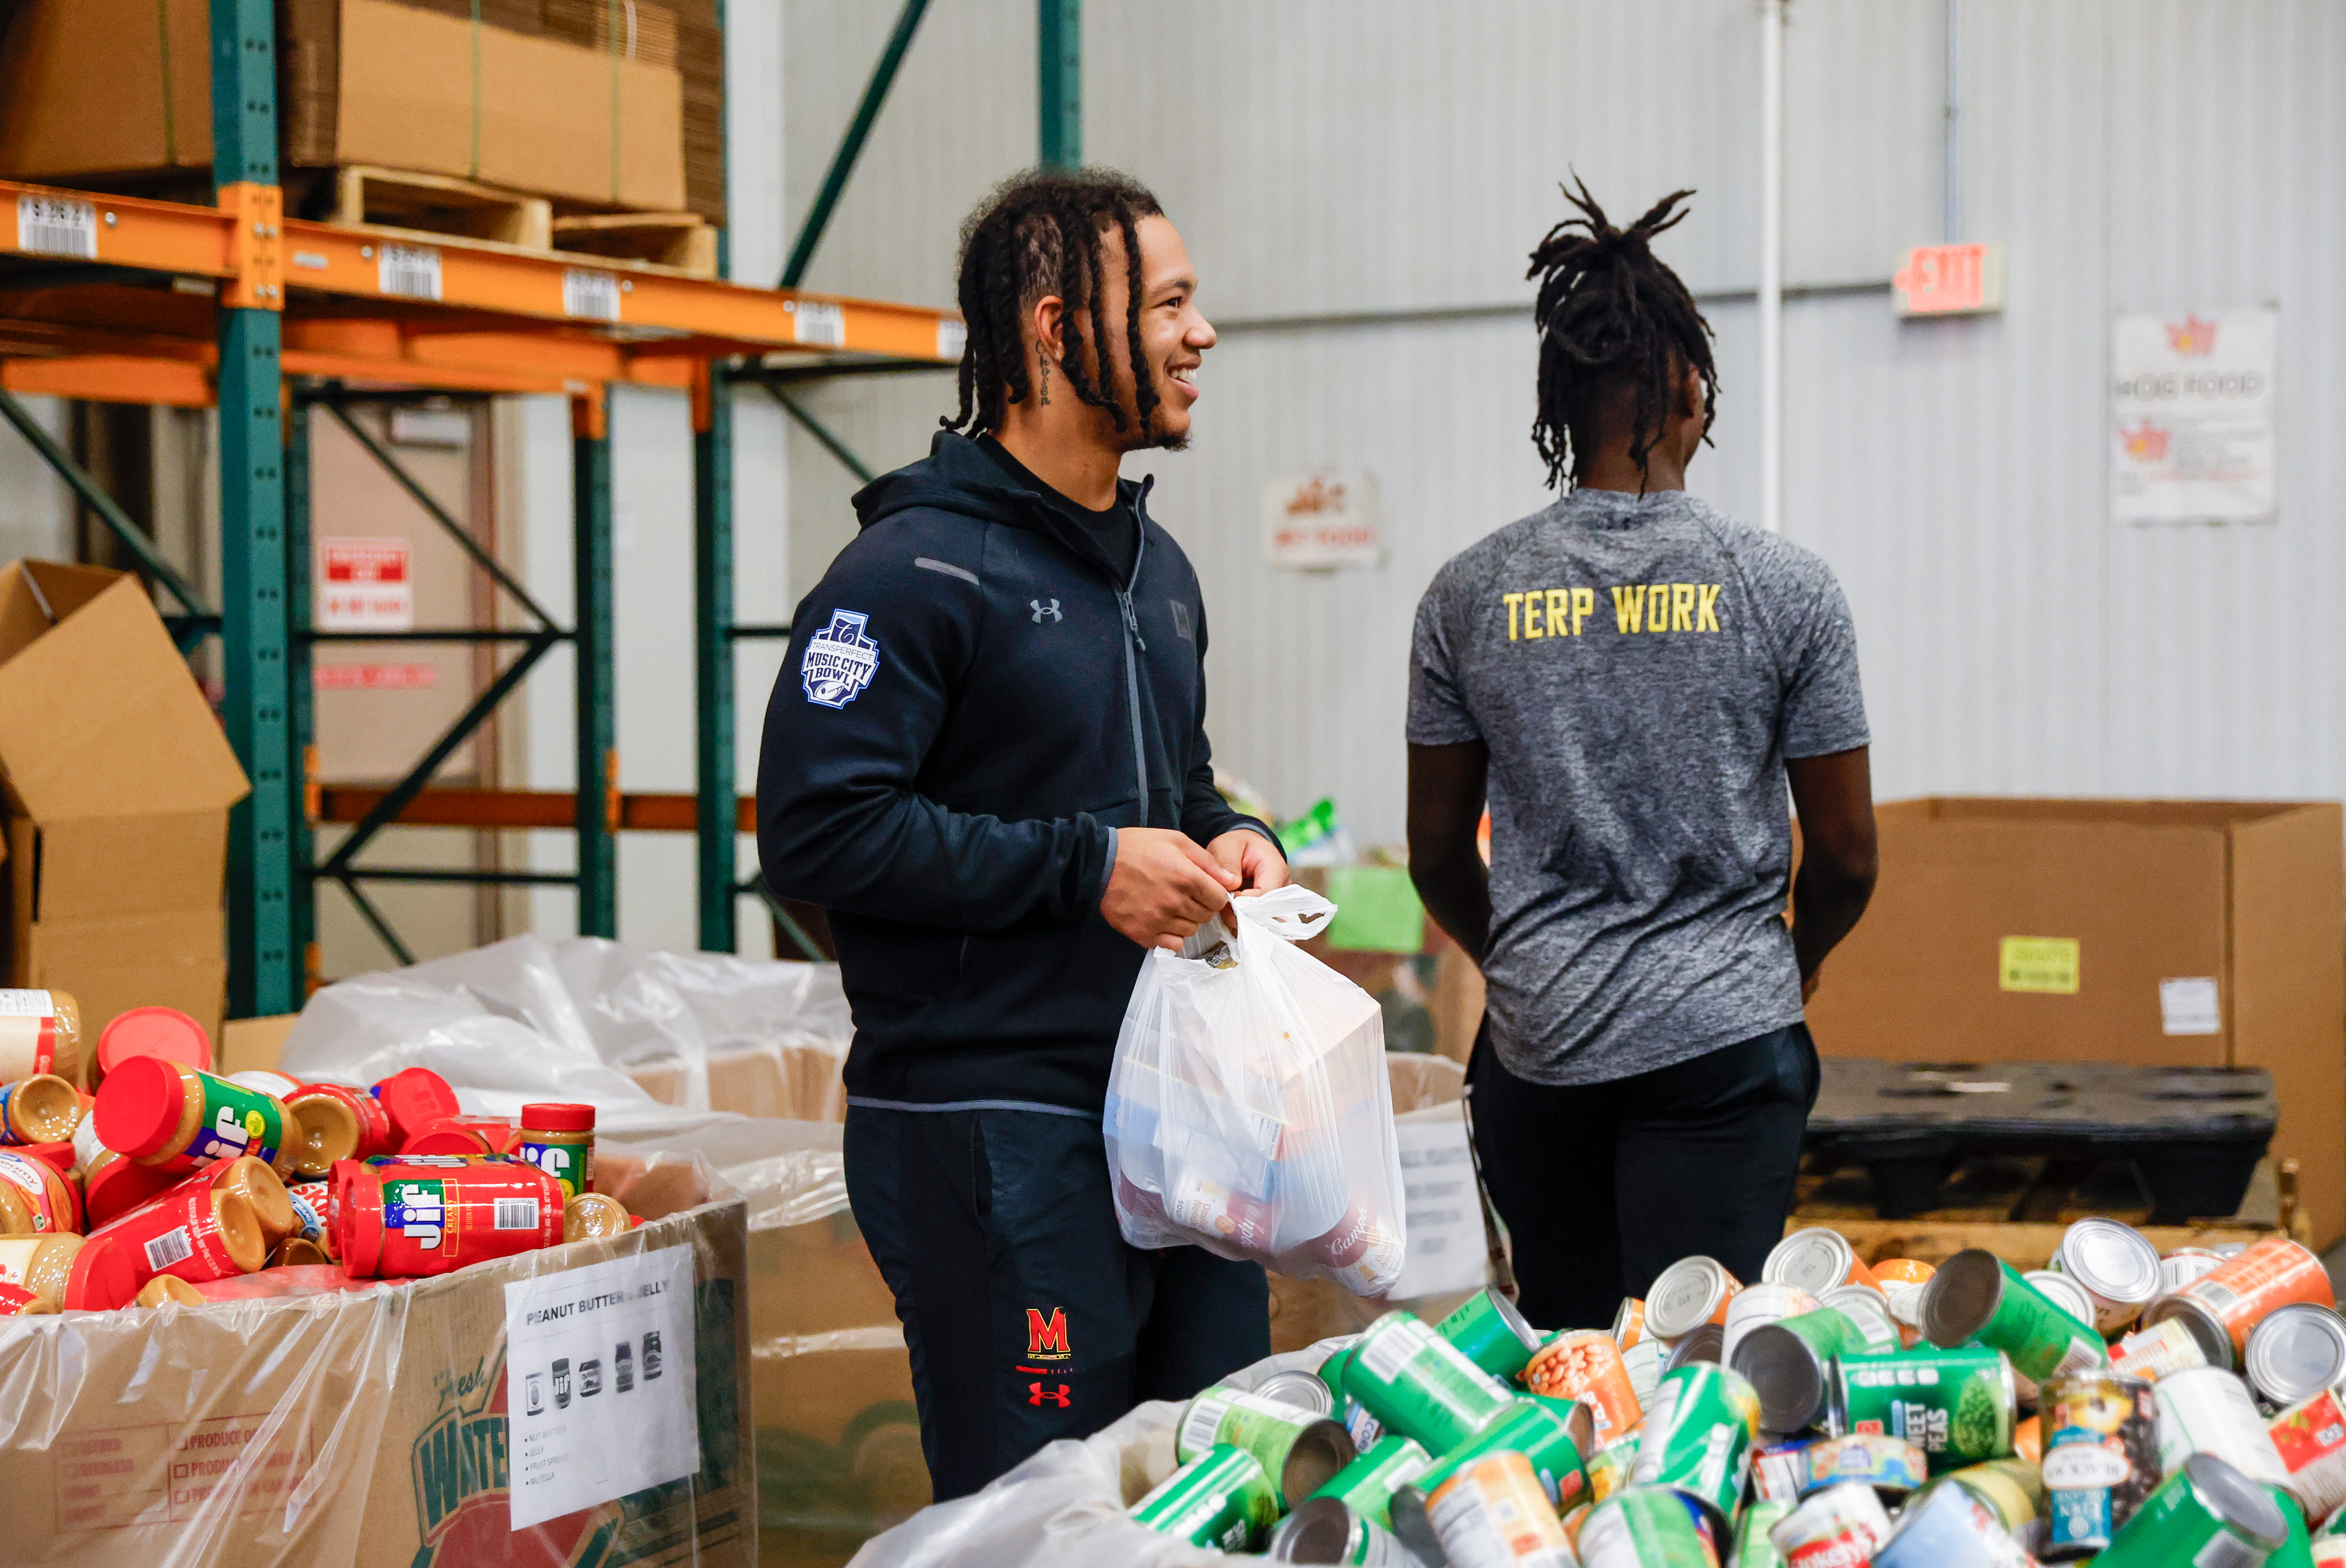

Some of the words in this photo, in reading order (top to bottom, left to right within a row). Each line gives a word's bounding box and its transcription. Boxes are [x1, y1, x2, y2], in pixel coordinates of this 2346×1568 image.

[1502, 587, 1594, 641] TERP
[1611, 584, 1721, 634] WORK
[806, 652, 840, 669] MUSIC
[840, 658, 872, 680] CITY
[813, 642, 873, 661] TRANSPERFECT
[814, 667, 850, 686] BOWL
[401, 1184, 442, 1250] Jif
[1200, 1203, 1212, 1229] Doub
[526, 1302, 574, 1325] PEANUT
[579, 1291, 623, 1313] BUTTER
[1026, 1307, 1071, 1353] M
[192, 1458, 241, 1477] PRODU
[420, 1417, 510, 1530] WATE
